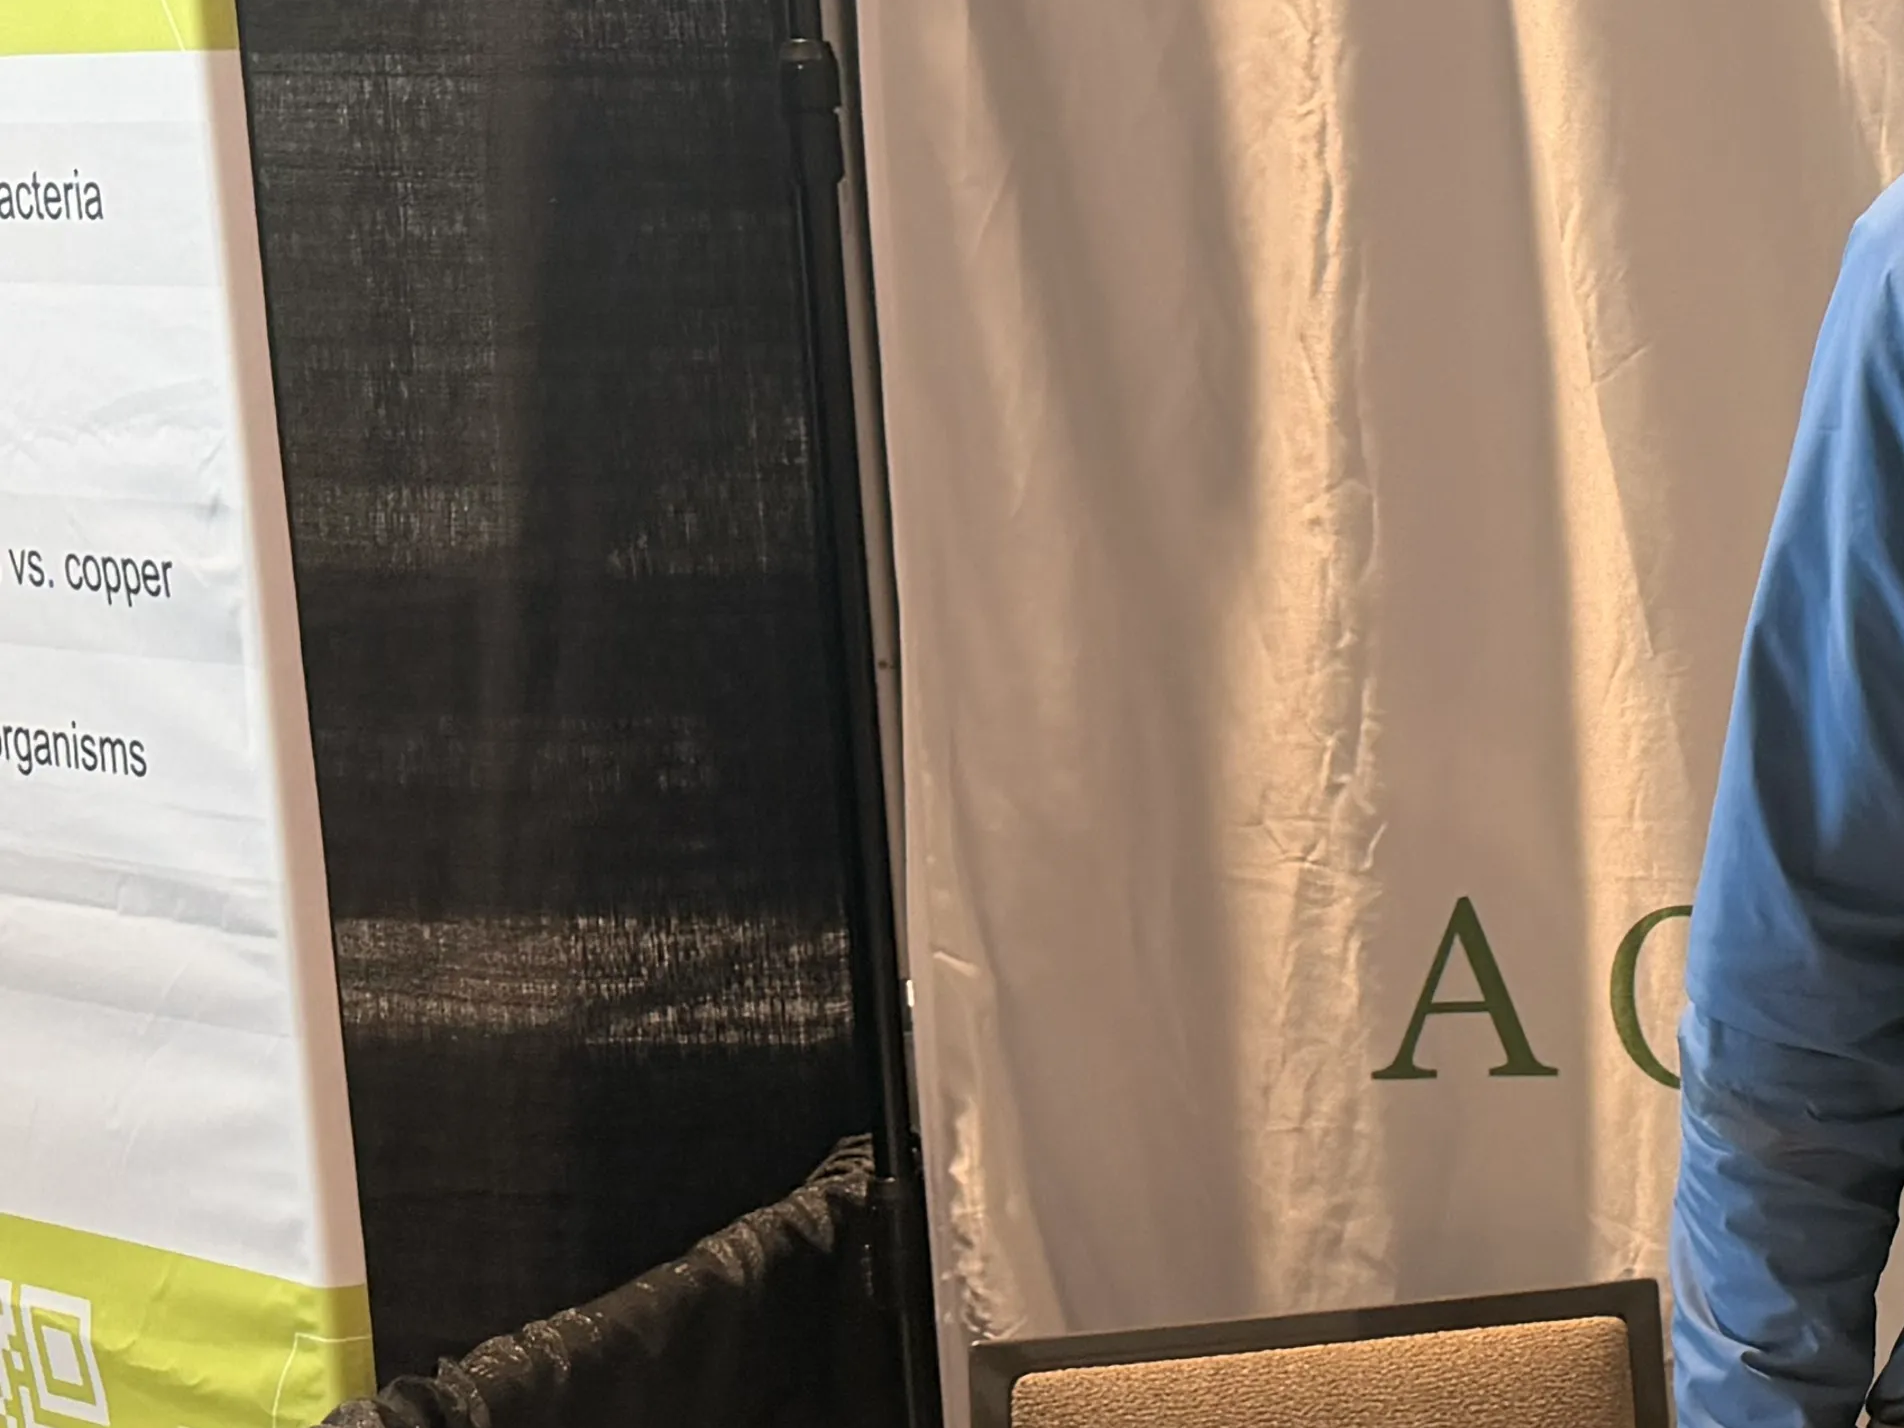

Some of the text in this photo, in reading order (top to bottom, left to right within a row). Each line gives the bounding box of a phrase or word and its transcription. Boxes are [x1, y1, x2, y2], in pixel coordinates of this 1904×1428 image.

[9, 549, 173, 607] vs. copper
[0, 720, 147, 777] rganisms
